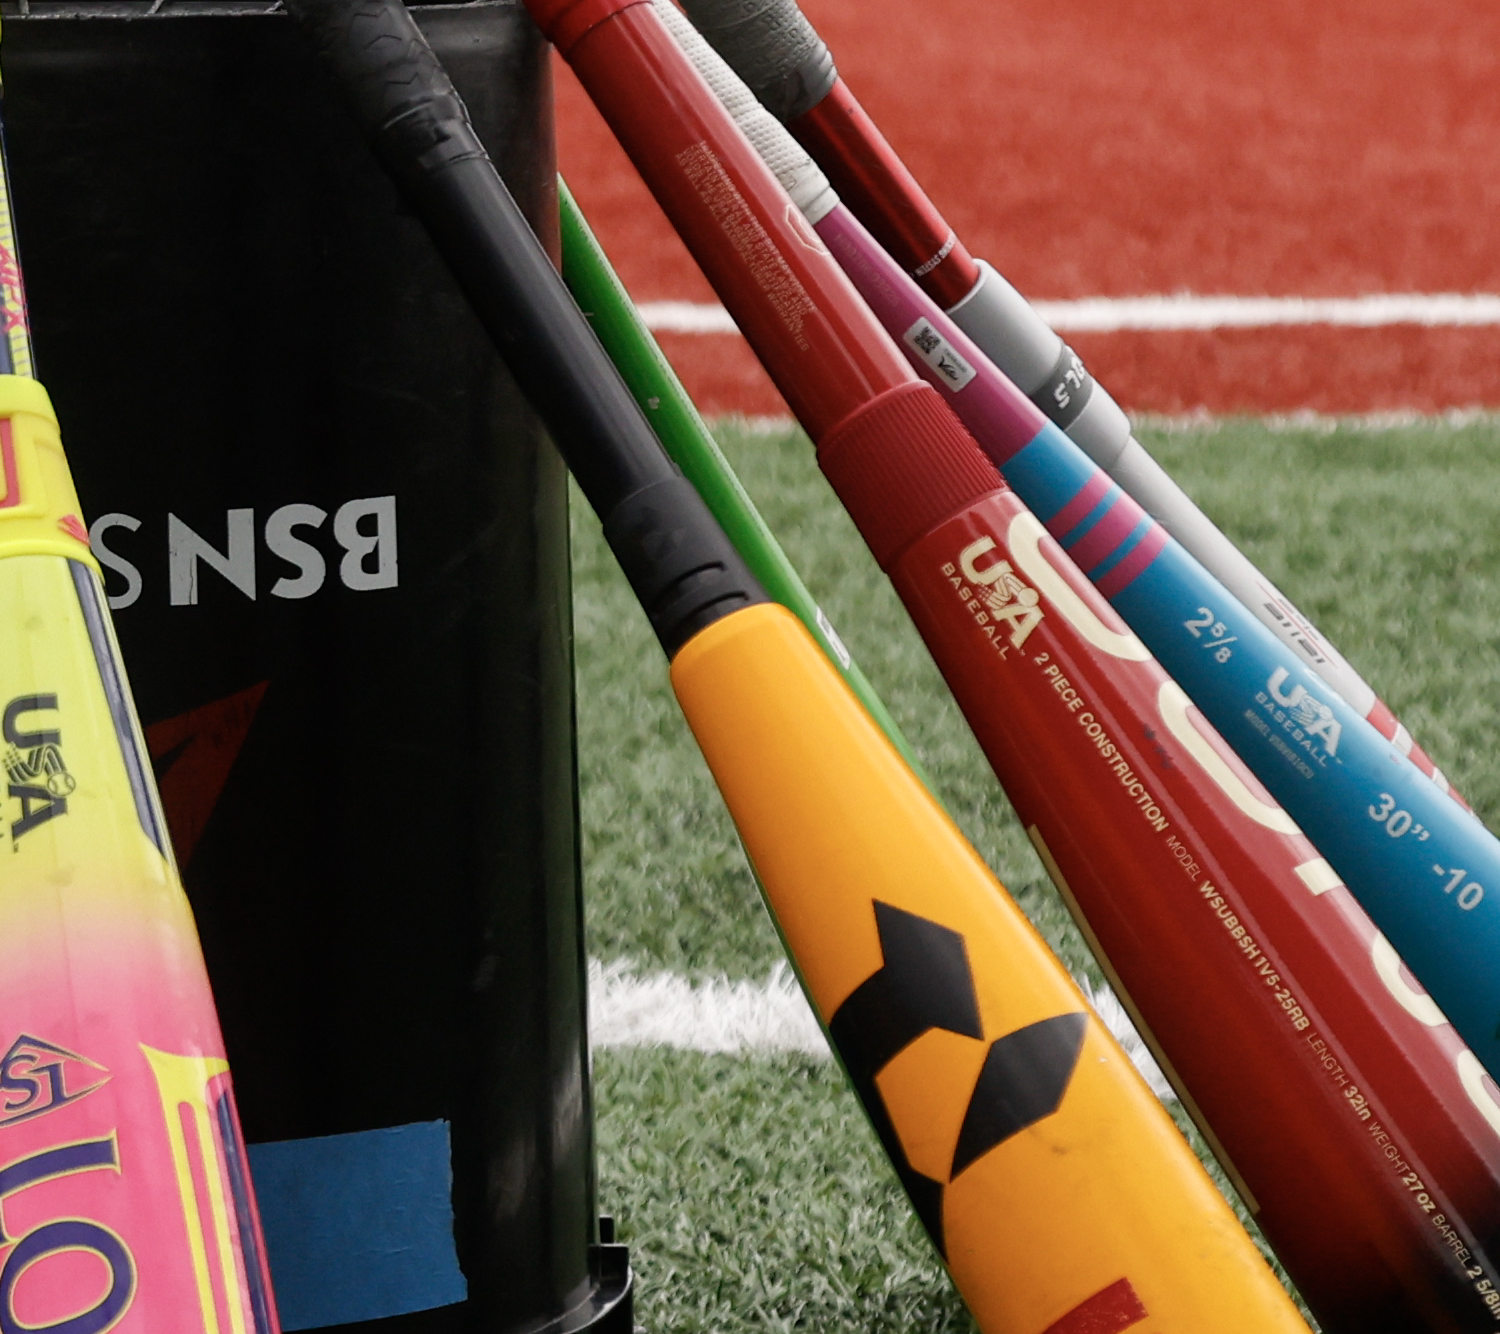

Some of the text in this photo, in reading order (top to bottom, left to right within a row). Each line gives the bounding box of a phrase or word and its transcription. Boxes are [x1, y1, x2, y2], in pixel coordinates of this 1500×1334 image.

[701, 176, 719, 196] THE
[713, 194, 730, 214] USA
[674, 152, 689, 167] AS
[683, 165, 704, 190] WELL
[698, 188, 713, 204] AS
[707, 202, 724, 221] ALL
[764, 289, 810, 352] WARRANTIES
[741, 221, 760, 242] AND
[790, 295, 808, 316] AND
[169, 495, 399, 607] BSN
[960, 534, 1045, 651] USA
[940, 560, 1013, 661] BASEBALL
[1253, 690, 1331, 768] BASEBALL
[1268, 664, 1342, 757] USA
[2, 692, 77, 842] USA
[1431, 863, 1485, 914] -10
[1032, 650, 1050, 666] 2
[1042, 662, 1085, 713] PIECE
[1075, 709, 1171, 833] CONSTRUCTION
[1164, 832, 1204, 882] MODEL
[1305, 1032, 1351, 1089] LENGTH
[1341, 1084, 1374, 1122] 32in
[1365, 1120, 1411, 1177] WEIGHT
[1430, 1212, 1475, 1269] BARREL
[1466, 1264, 1482, 1280] 2
